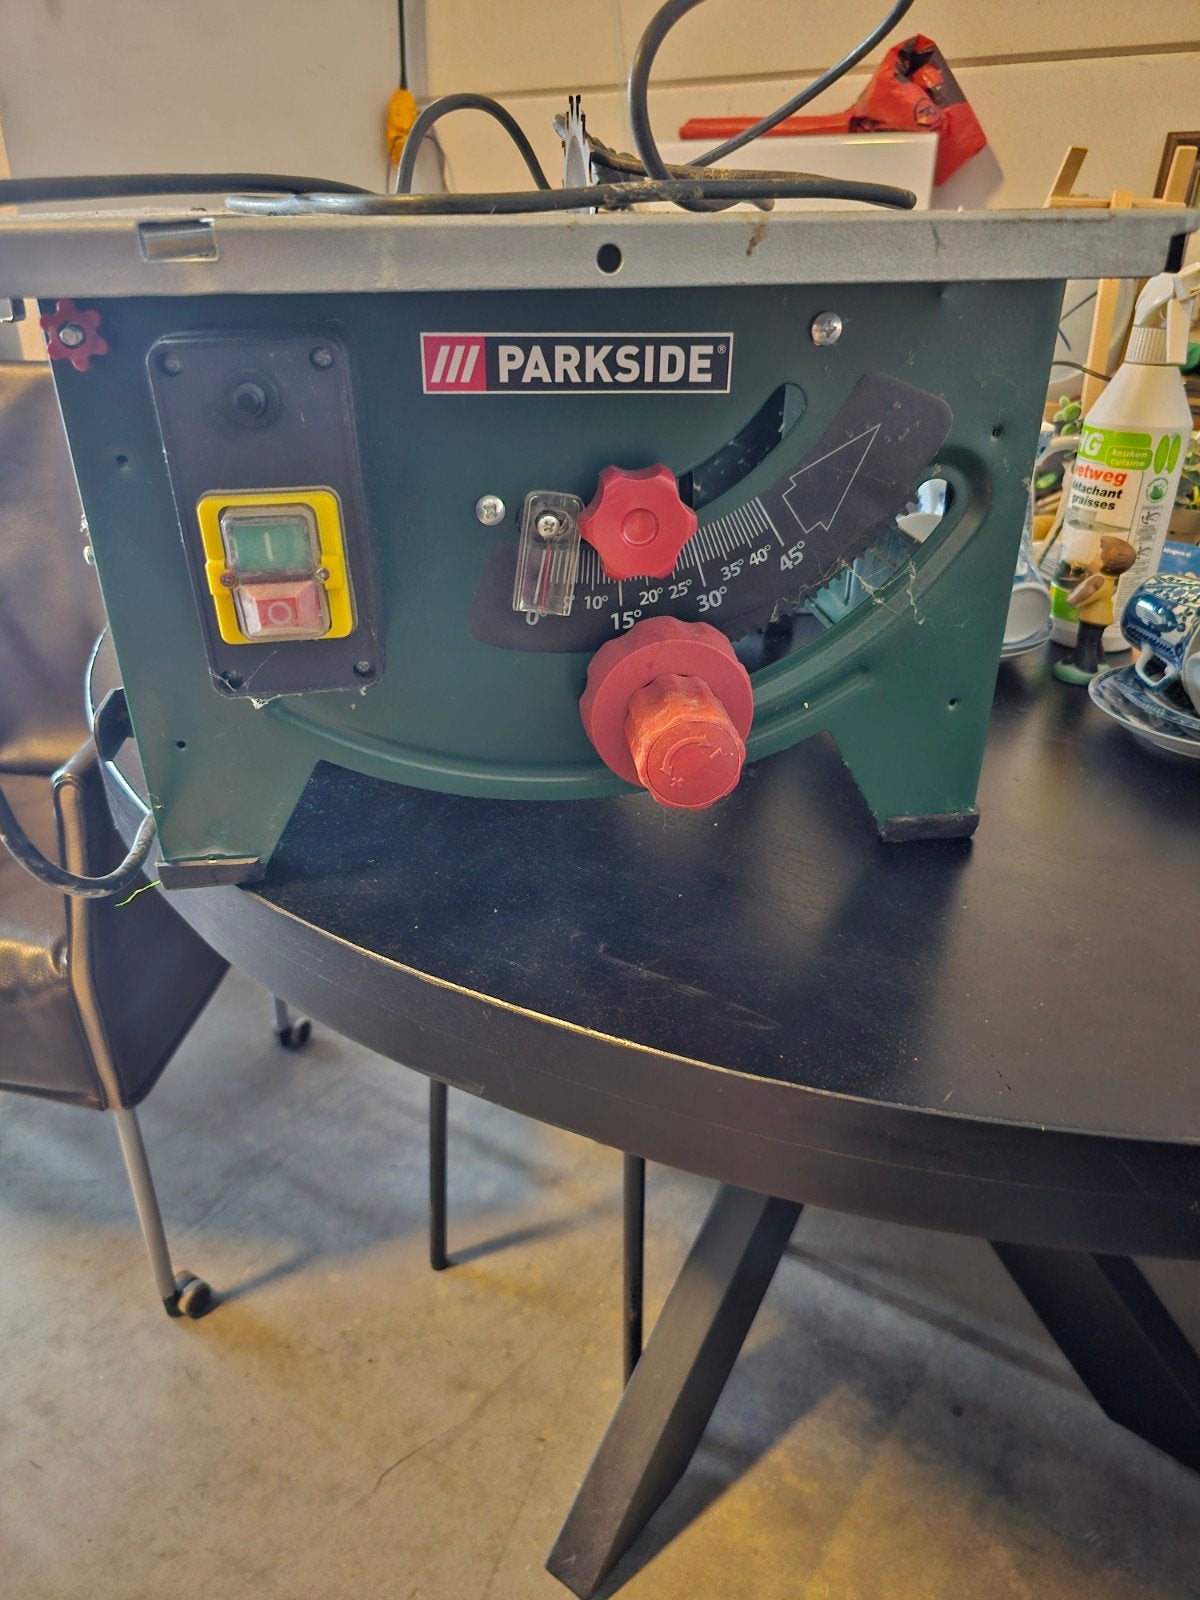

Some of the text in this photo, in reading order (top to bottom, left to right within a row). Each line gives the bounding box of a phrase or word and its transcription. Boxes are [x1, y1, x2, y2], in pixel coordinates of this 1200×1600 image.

[1111, 449, 1148, 458] keuken
[1110, 459, 1146, 467] cuisine
[584, 595, 609, 610] 10°
[610, 609, 643, 631] 15°
[639, 587, 664, 606] 20°
[668, 579, 693, 600] 25°
[696, 586, 728, 613] 30°
[720, 559, 745, 581] 35°
[749, 544, 772, 566] 40°
[779, 540, 806, 572] 45°
